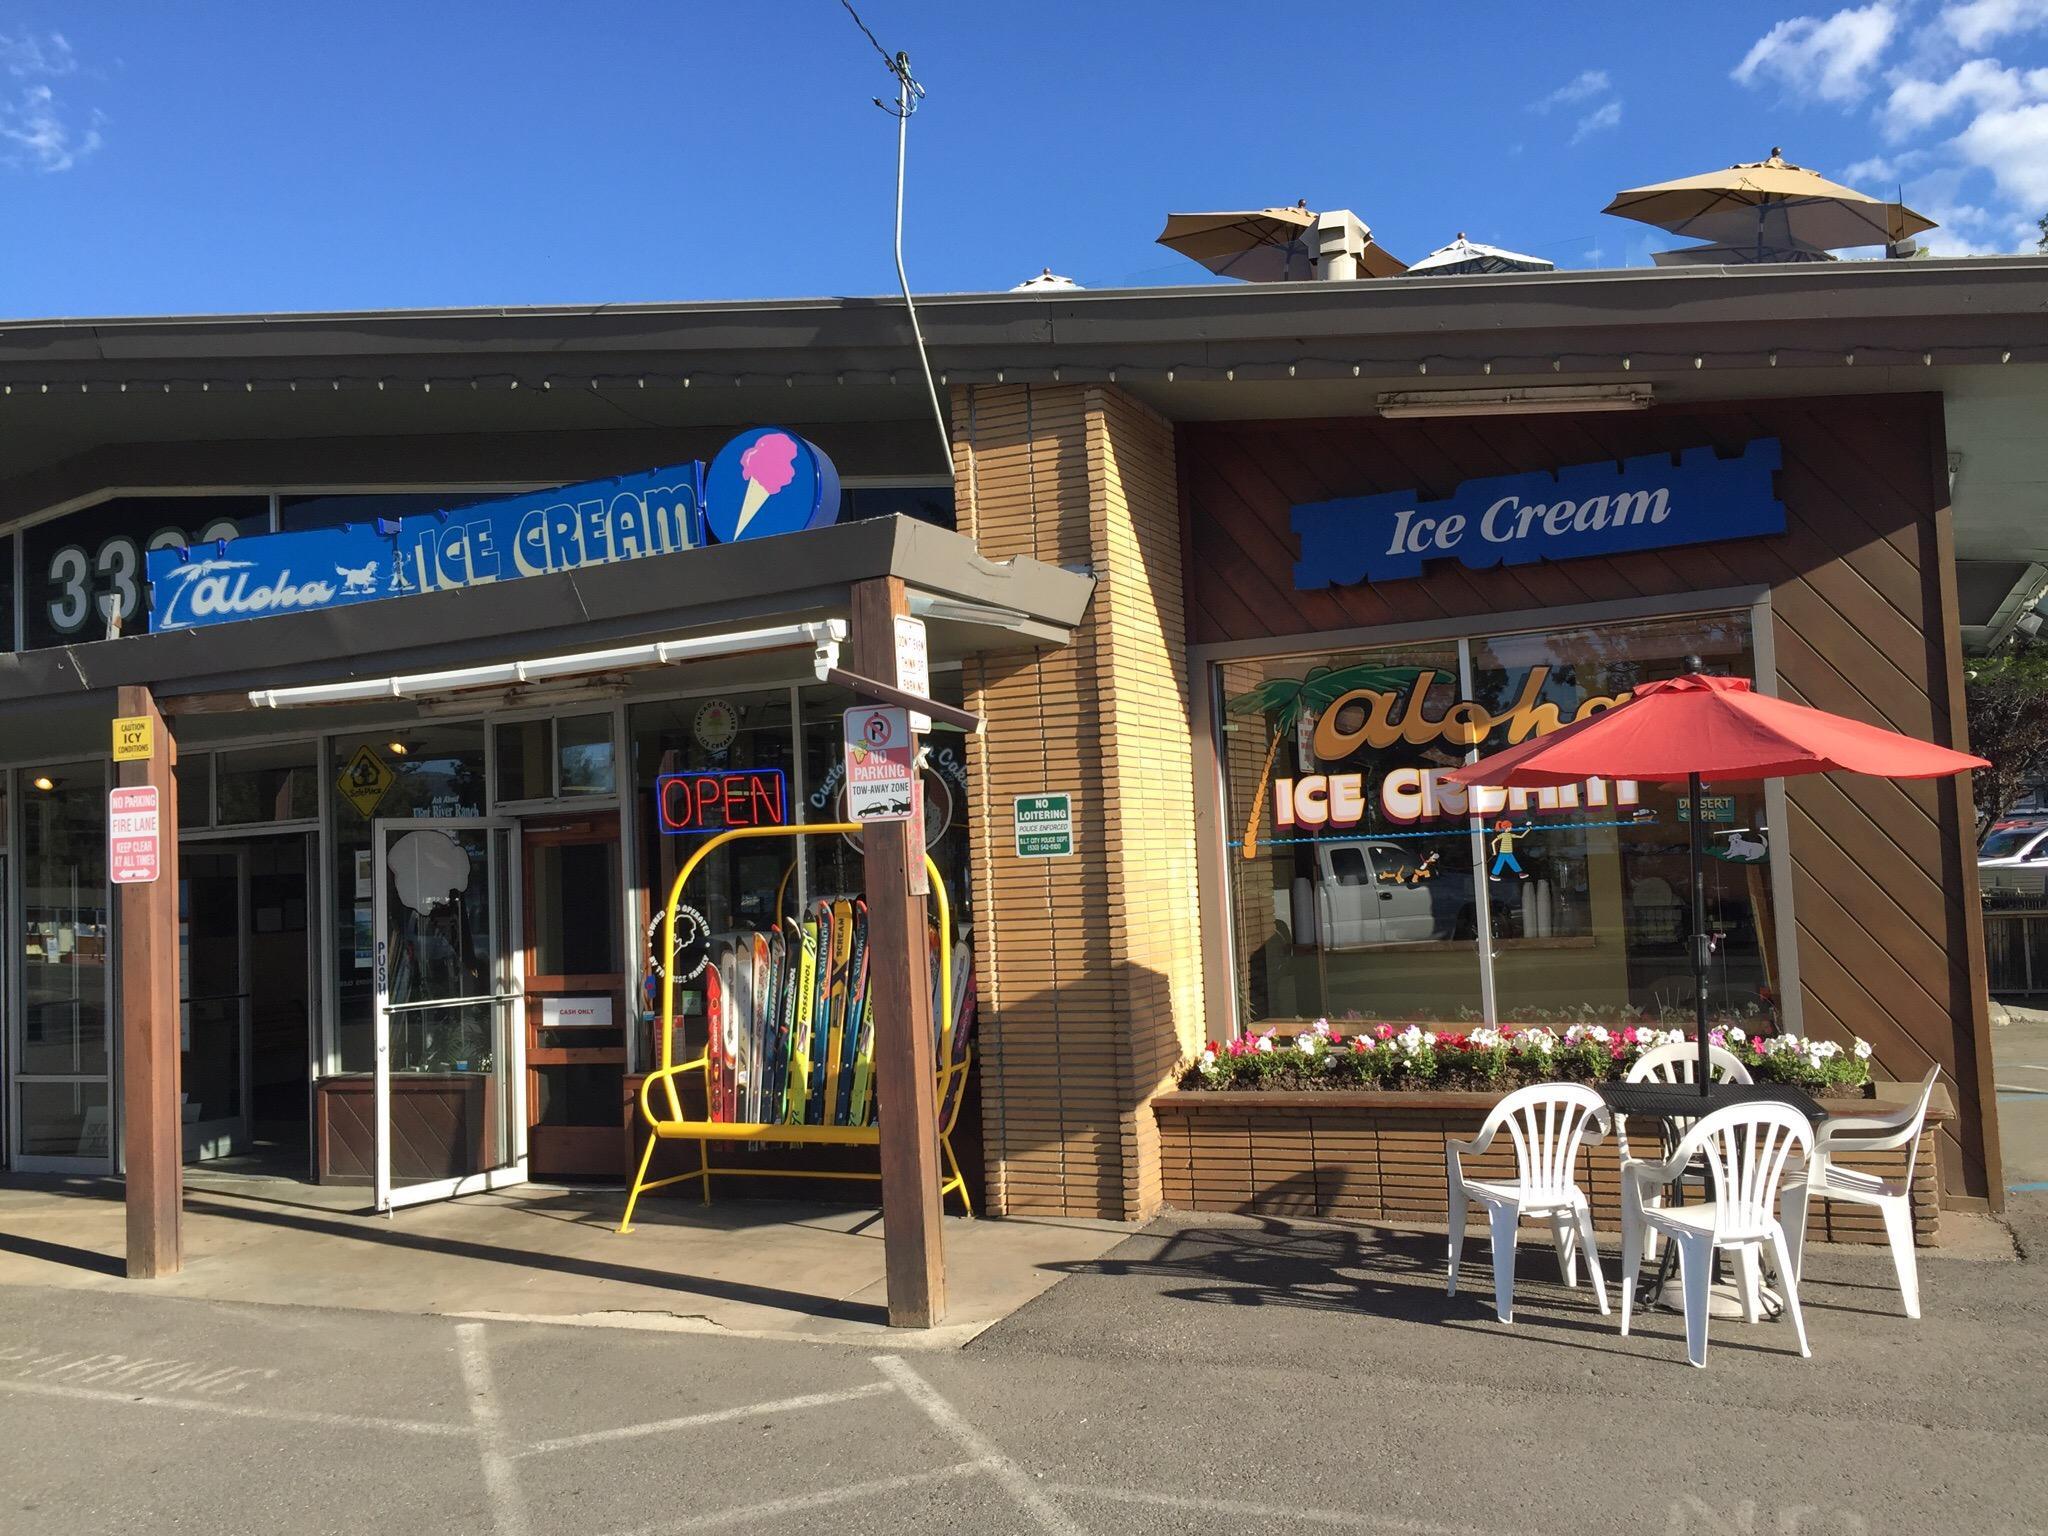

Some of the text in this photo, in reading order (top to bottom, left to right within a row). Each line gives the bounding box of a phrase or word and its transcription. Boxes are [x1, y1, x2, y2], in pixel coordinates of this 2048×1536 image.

[1385, 487, 1672, 556] Ice Cream
[415, 483, 701, 594] ICE CREAM
[49, 517, 241, 634] 33
[121, 722, 145, 732] CAUTION
[124, 733, 142, 744] ICY
[118, 743, 149, 754] CONDITIONS
[870, 750, 887, 765] NO
[854, 763, 905, 780] PARKING
[852, 781, 909, 796] TOW-AWAY ZONE
[112, 794, 156, 810] NO PARKING
[661, 774, 781, 828] OPEN
[1035, 799, 1049, 809] NO
[1275, 772, 1365, 827] ICE
[1679, 798, 1731, 809] DSERT
[432, 803, 453, 818] River
[455, 803, 480, 818] Ranch
[1019, 809, 1067, 821] LOITERING
[112, 815, 157, 833] FIRE LANE
[1019, 823, 1068, 832] POLICE ENFORCED
[116, 839, 153, 854] KEEP CLEAR
[1040, 836, 1056, 844] POLICE
[114, 853, 155, 867] AT ALL TIMES
[682, 904, 711, 937] OPERATED
[835, 917, 845, 957] SCREAM
[818, 921, 830, 976] SALOMON
[854, 922, 867, 977] SALOMON
[377, 941, 386, 996] PUSH
[769, 963, 779, 1026] ROSSIGNOL
[784, 967, 797, 1025] ROSSIGNOL
[801, 964, 812, 1022] ROSSIGNOL
